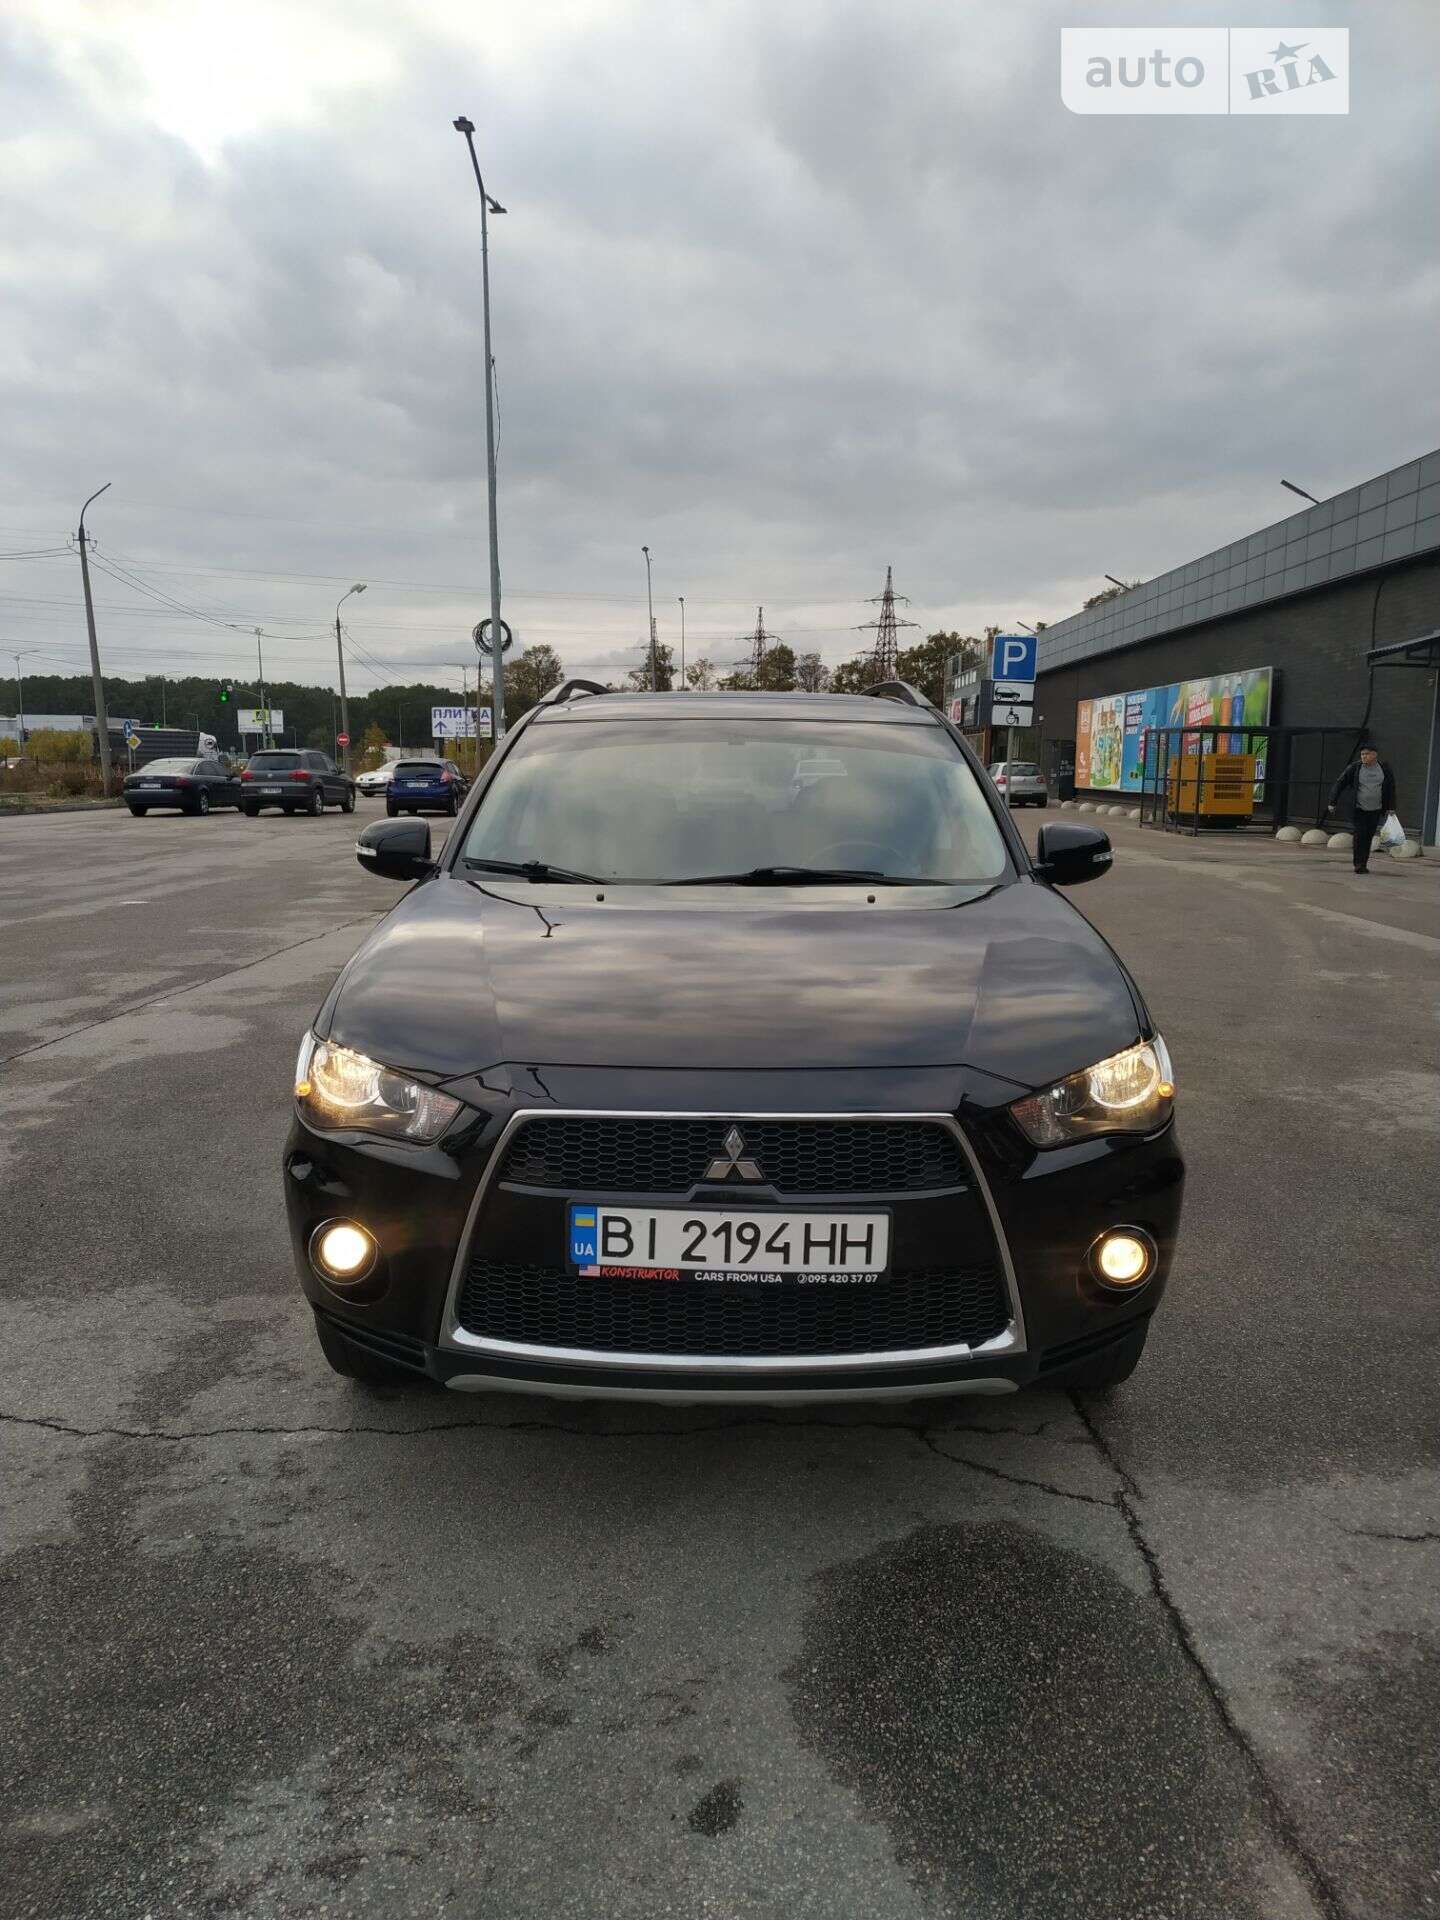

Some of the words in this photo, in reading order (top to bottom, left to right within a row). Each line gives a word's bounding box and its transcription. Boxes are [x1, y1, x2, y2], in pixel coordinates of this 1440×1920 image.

[1002, 641, 1027, 676] P
[601, 1215, 656, 1260] BI
[680, 1219, 790, 1265] 2194
[802, 1222, 874, 1265] HH
[574, 1242, 594, 1256] UA
[600, 1265, 680, 1281] KONSTRUKTOR
[694, 1271, 724, 1282] CARS
[726, 1271, 758, 1283] FROM
[760, 1272, 783, 1283] USA
[829, 1273, 849, 1284] 420
[850, 1273, 864, 1284] 37
[865, 1273, 878, 1284] 07
